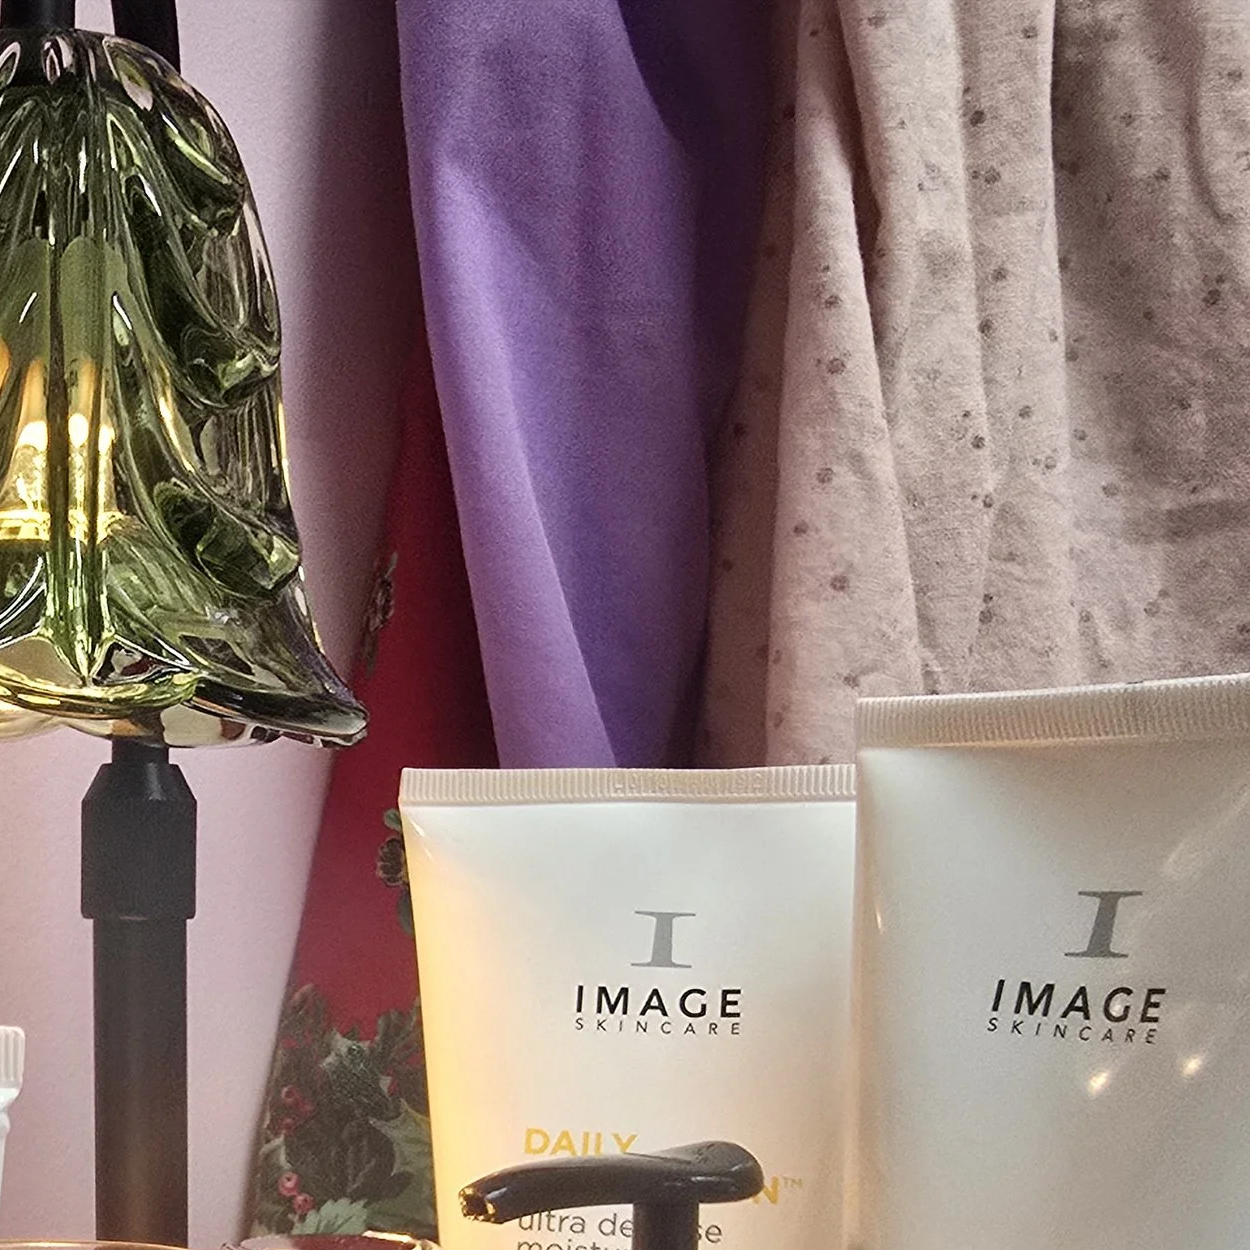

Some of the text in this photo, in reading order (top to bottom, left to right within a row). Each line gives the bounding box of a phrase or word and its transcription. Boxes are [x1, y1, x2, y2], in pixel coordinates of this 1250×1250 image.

[576, 984, 742, 1019] IMAGE
[991, 978, 1166, 1023] IMAGE
[575, 1017, 741, 1036] SKINCARE
[987, 1016, 1158, 1045] SKINCARE
[518, 1210, 586, 1234] ultra
